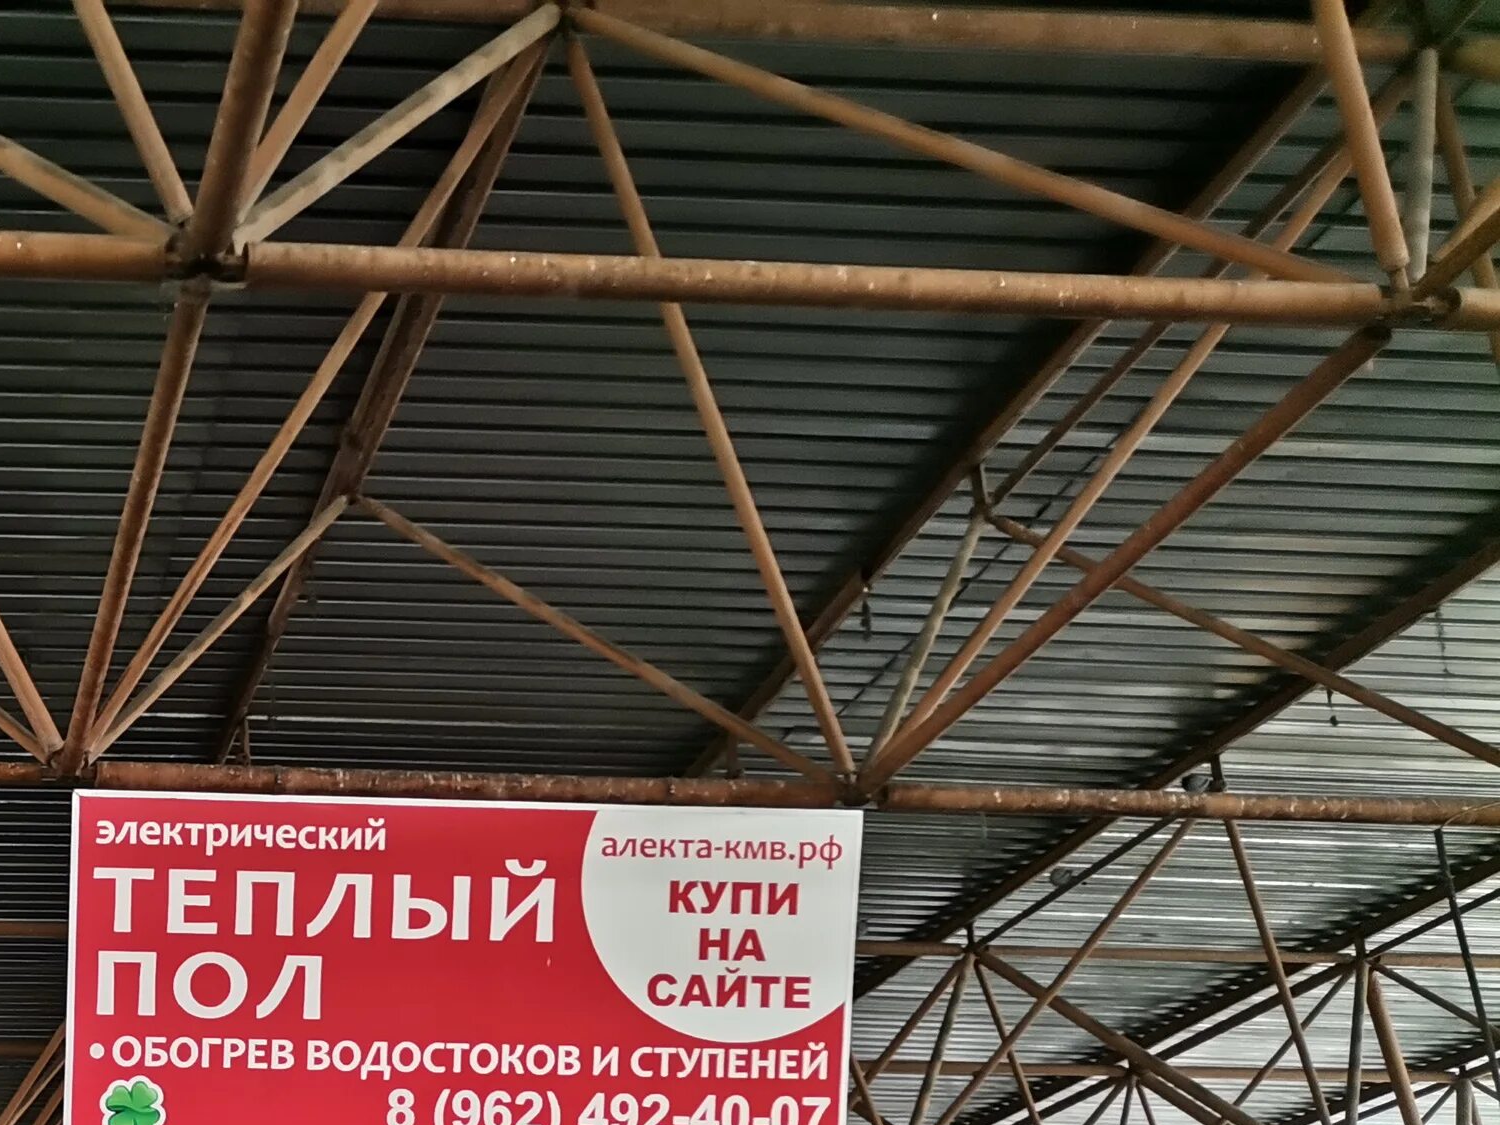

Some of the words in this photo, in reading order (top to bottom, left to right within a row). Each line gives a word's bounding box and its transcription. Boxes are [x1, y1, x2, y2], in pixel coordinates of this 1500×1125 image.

[95, 817, 386, 857] электрический
[601, 834, 844, 873] алекта-кмв.рф
[93, 859, 556, 942] ТЕПЛЫЙ
[668, 880, 799, 916] КУПИ
[698, 927, 766, 962] НА
[96, 951, 323, 1020] ПОЛ
[647, 967, 812, 1009] САЙТЕ
[112, 1036, 295, 1070] ОБОГРЕВ
[306, 1039, 581, 1081] ВОДОСТОКОВ
[592, 1046, 620, 1077] И
[630, 1041, 829, 1081] СТУПЕНЕЙ
